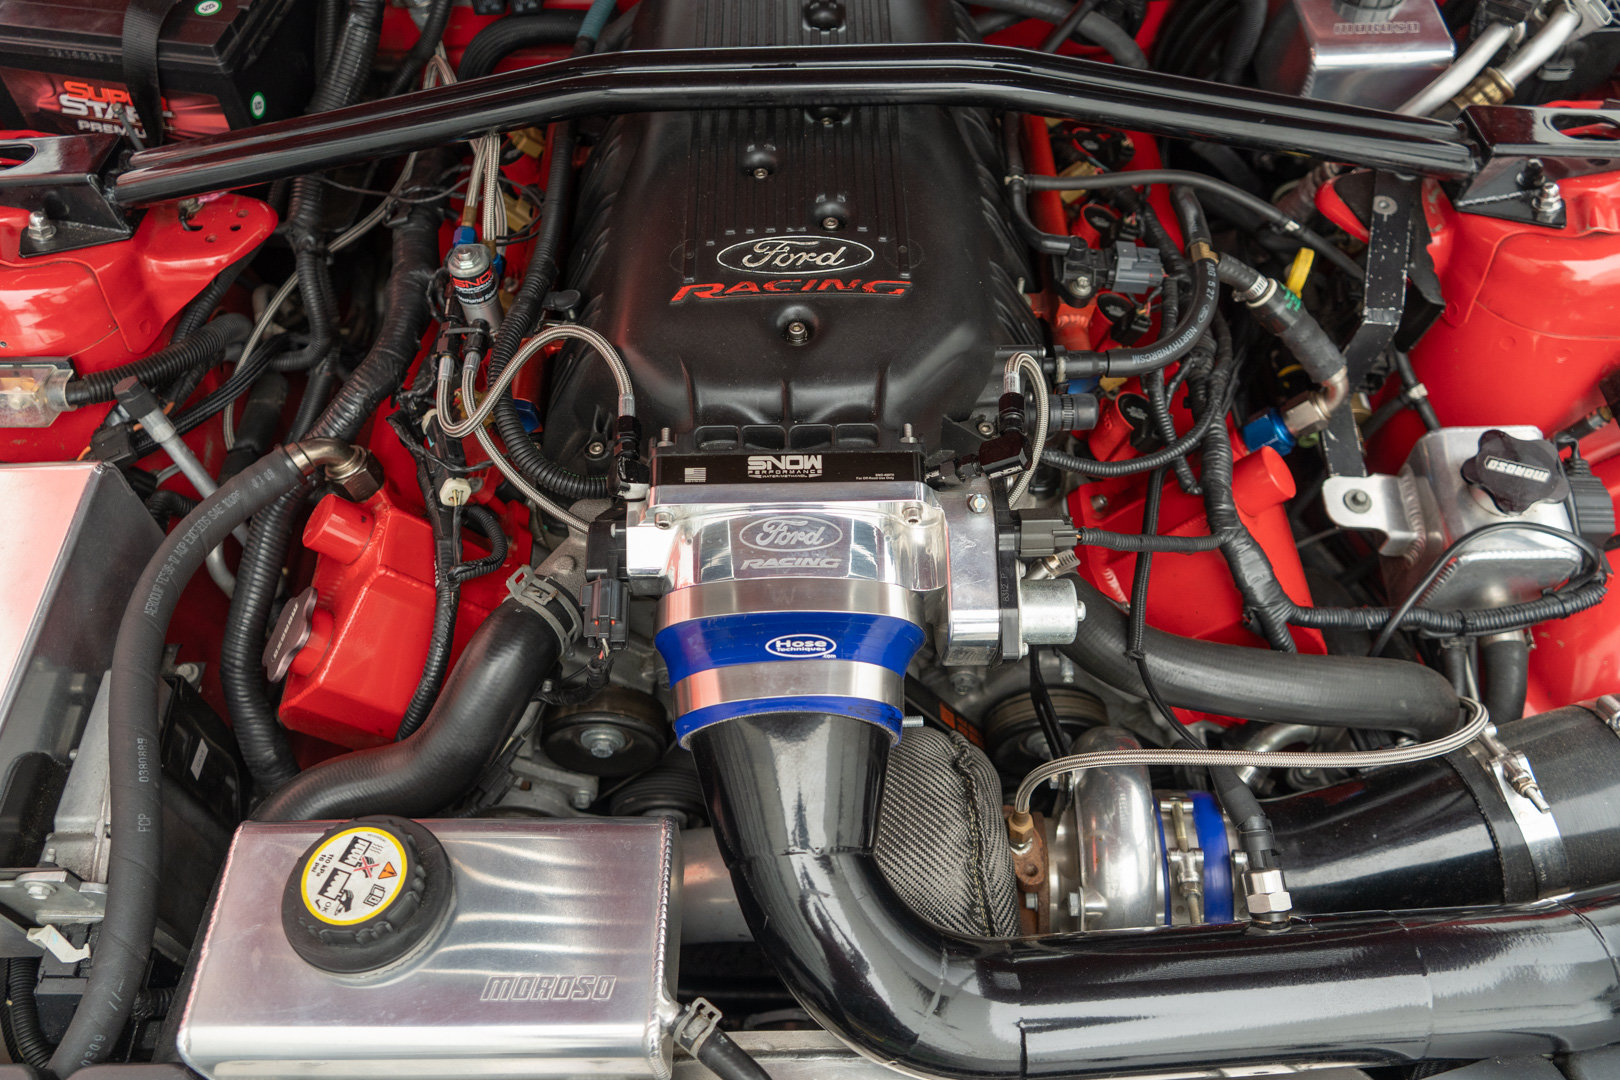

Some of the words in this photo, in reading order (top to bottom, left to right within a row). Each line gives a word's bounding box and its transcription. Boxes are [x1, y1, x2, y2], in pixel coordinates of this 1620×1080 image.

[742, 239, 846, 268] Ford
[670, 278, 913, 304] RACING
[747, 454, 823, 470] SNOW
[1487, 459, 1550, 483] MOROSO
[207, 503, 224, 520] SAE
[755, 519, 826, 546] Ford
[740, 557, 842, 570] RACING
[775, 639, 828, 648] Hose
[479, 974, 618, 1001] MOROSO
